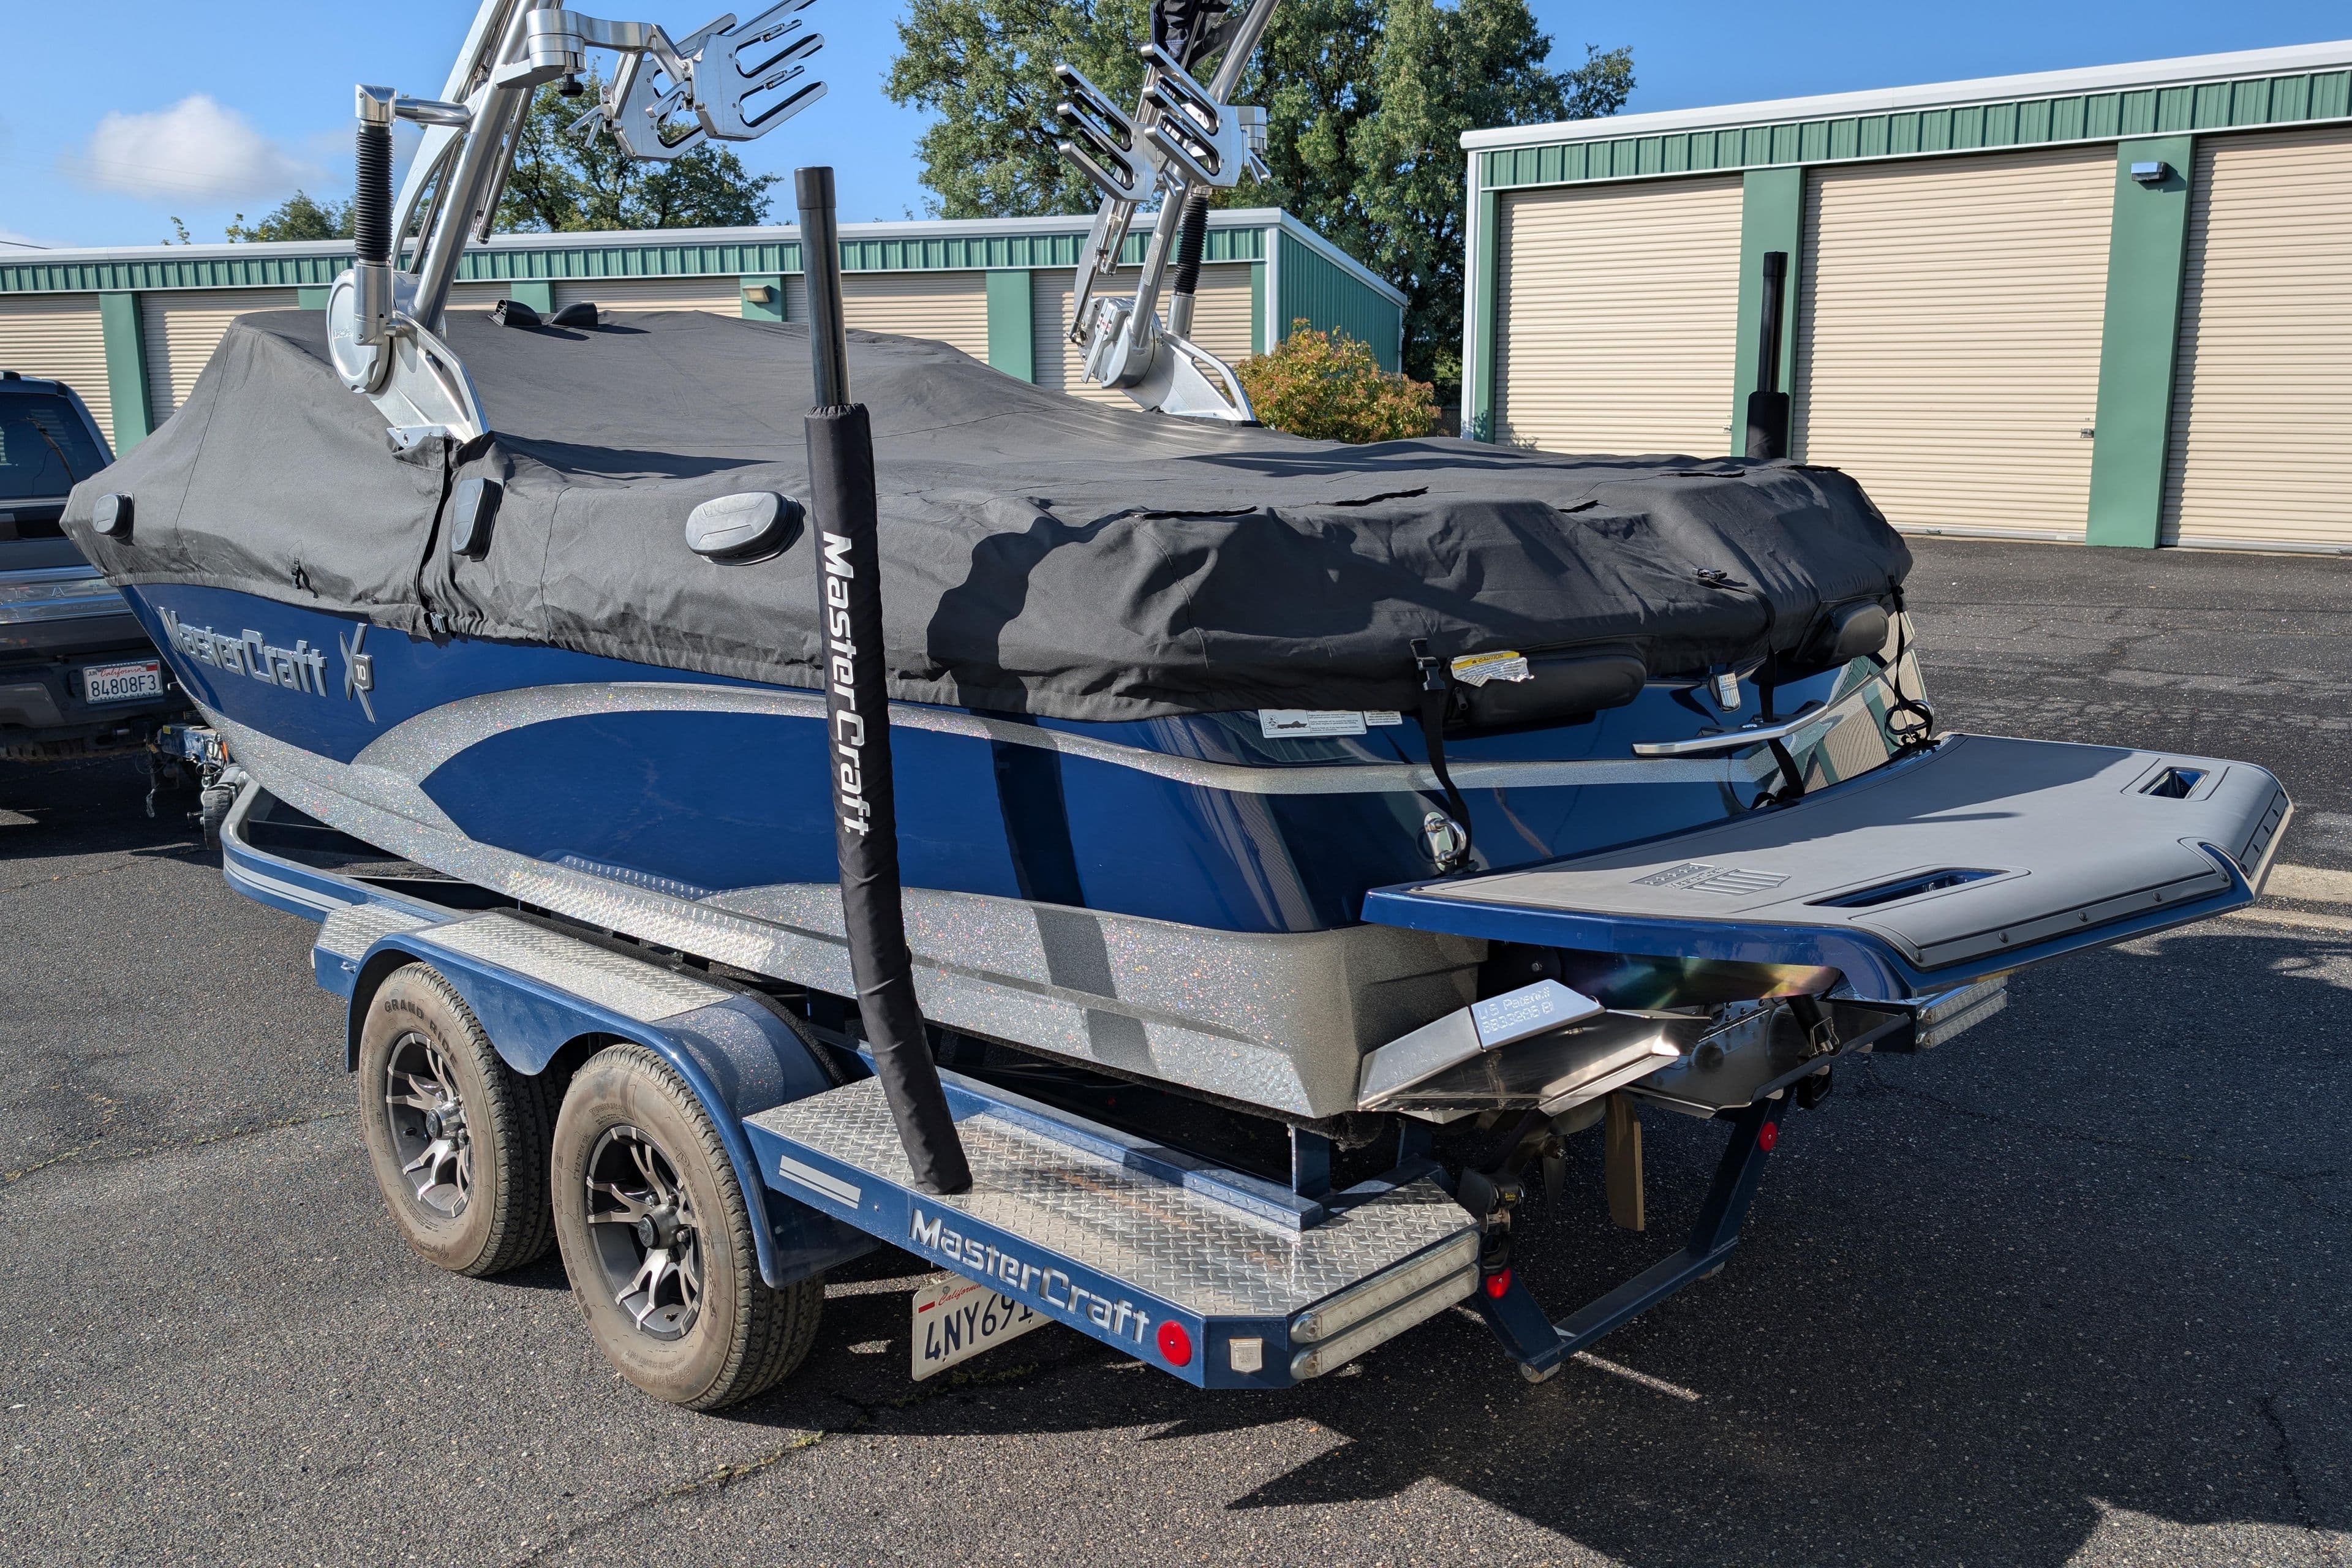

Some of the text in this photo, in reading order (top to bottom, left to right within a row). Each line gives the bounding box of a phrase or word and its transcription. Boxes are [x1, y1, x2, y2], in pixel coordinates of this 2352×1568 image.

[91, 674, 156, 697] 84808F3
[100, 666, 145, 677] California
[158, 606, 328, 697] MasterCraft
[823, 530, 870, 835] MasterCraft
[1478, 654, 1504, 663] CAUTION
[385, 999, 458, 1068] GRAND RIDE
[554, 1152, 592, 1321] GRAND RIDE
[909, 1208, 1150, 1344] MasterCraft
